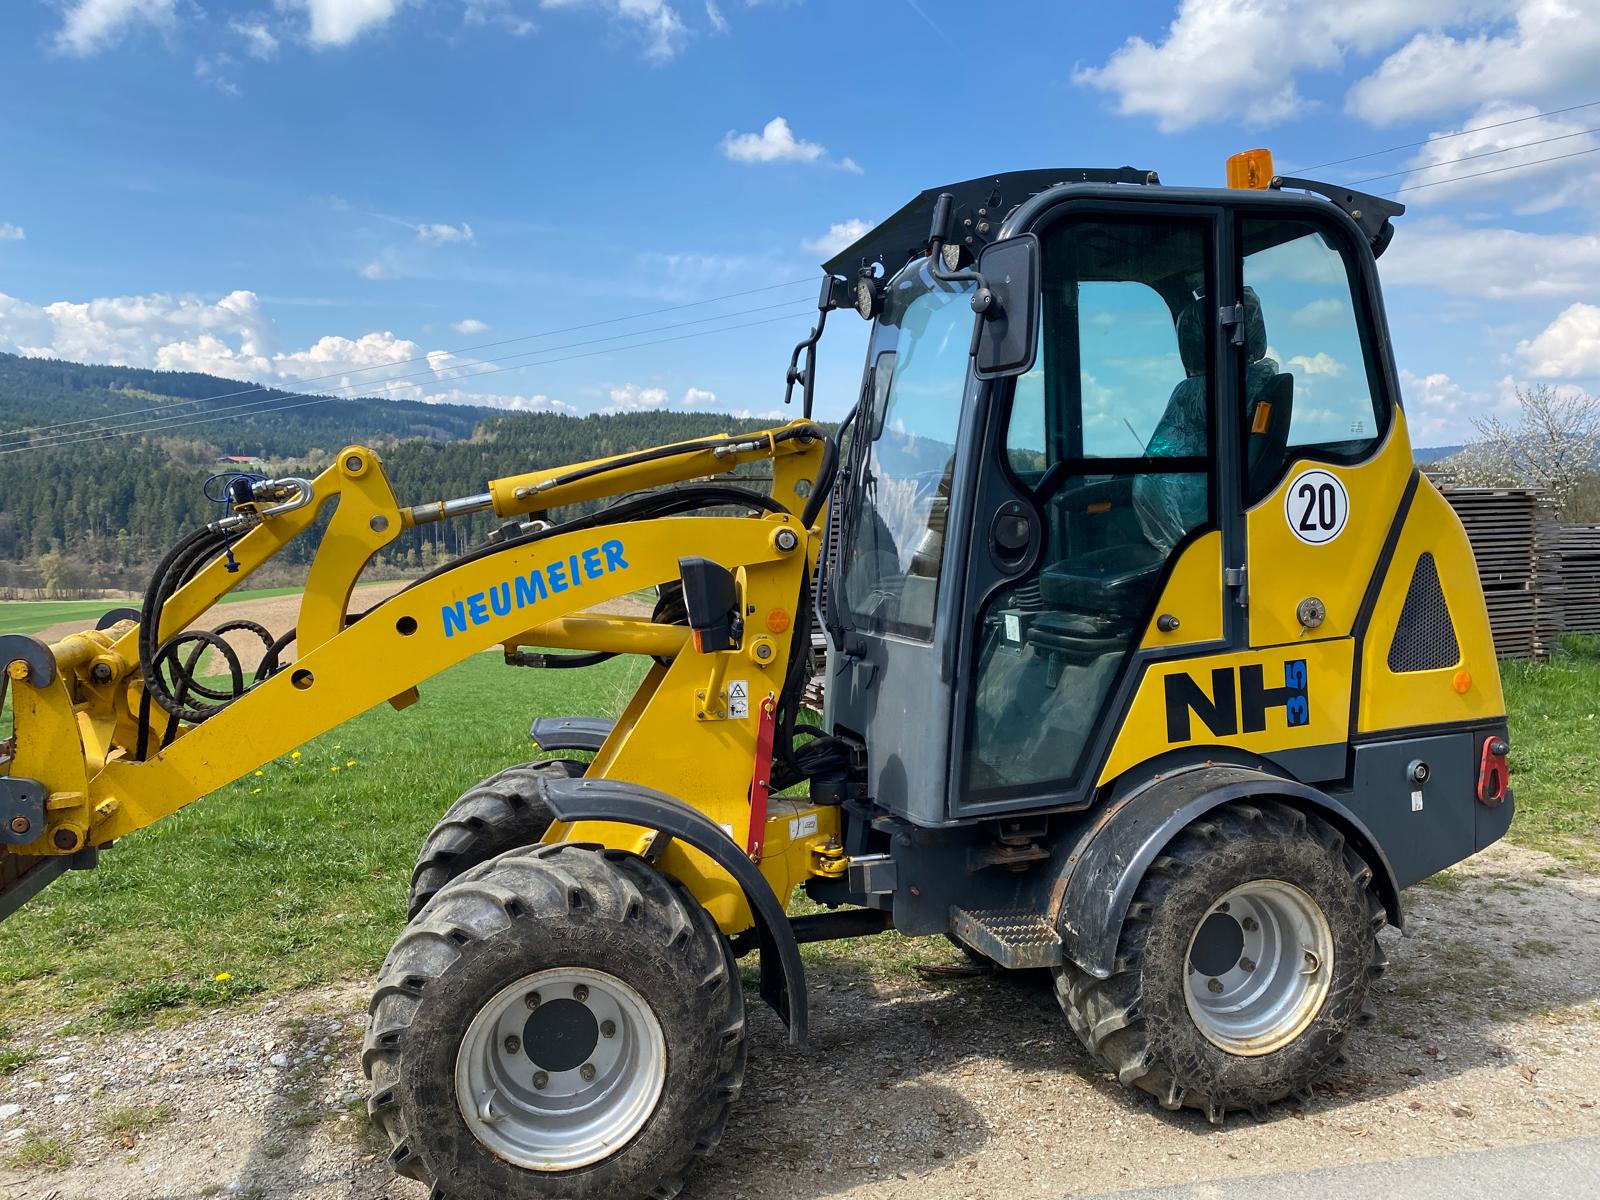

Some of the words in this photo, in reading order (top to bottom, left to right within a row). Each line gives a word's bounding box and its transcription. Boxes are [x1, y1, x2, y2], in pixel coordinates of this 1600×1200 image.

[1298, 483, 1336, 531] 20
[441, 539, 629, 638] NEUMEIER
[1164, 659, 1309, 743] NH
[1286, 661, 1307, 725] 35
